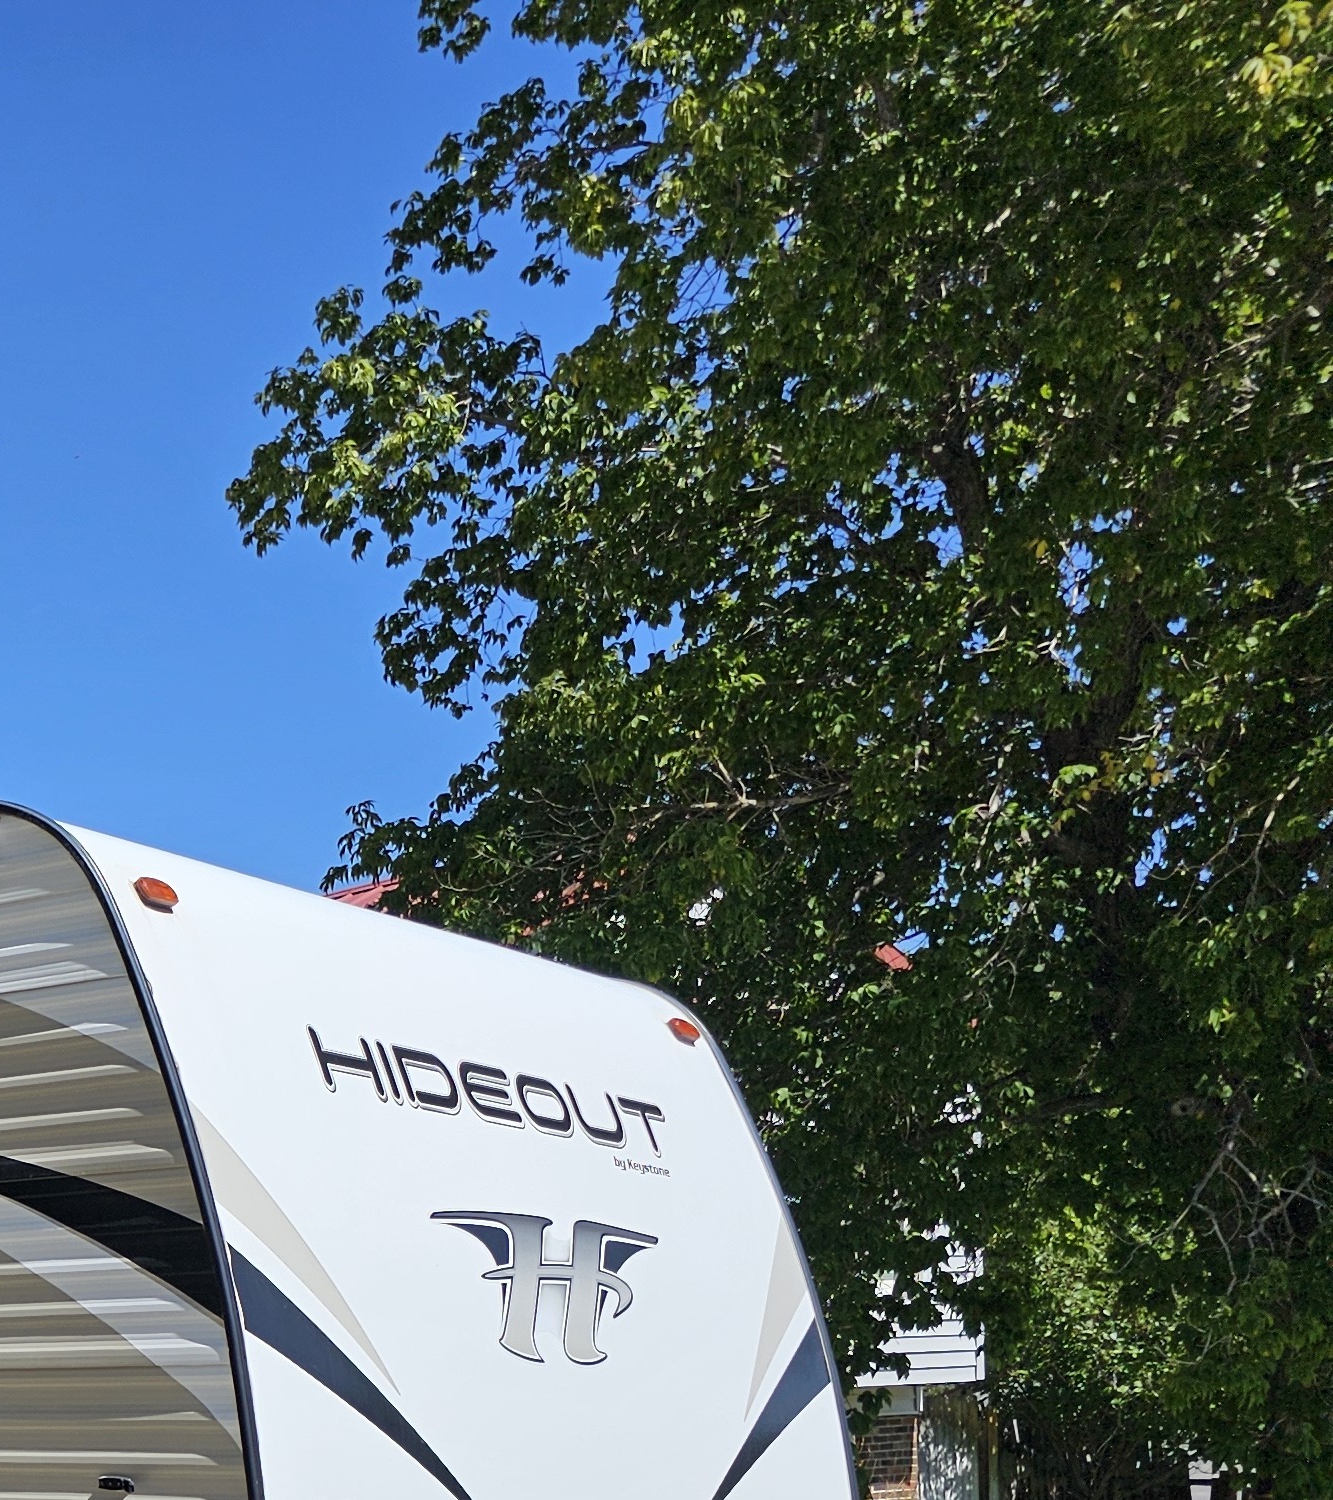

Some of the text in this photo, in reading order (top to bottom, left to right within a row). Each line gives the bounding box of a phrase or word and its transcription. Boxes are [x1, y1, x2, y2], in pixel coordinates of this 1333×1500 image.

[306, 1023, 666, 1158] HIDEOUT
[613, 1155, 671, 1178] by Keystone
